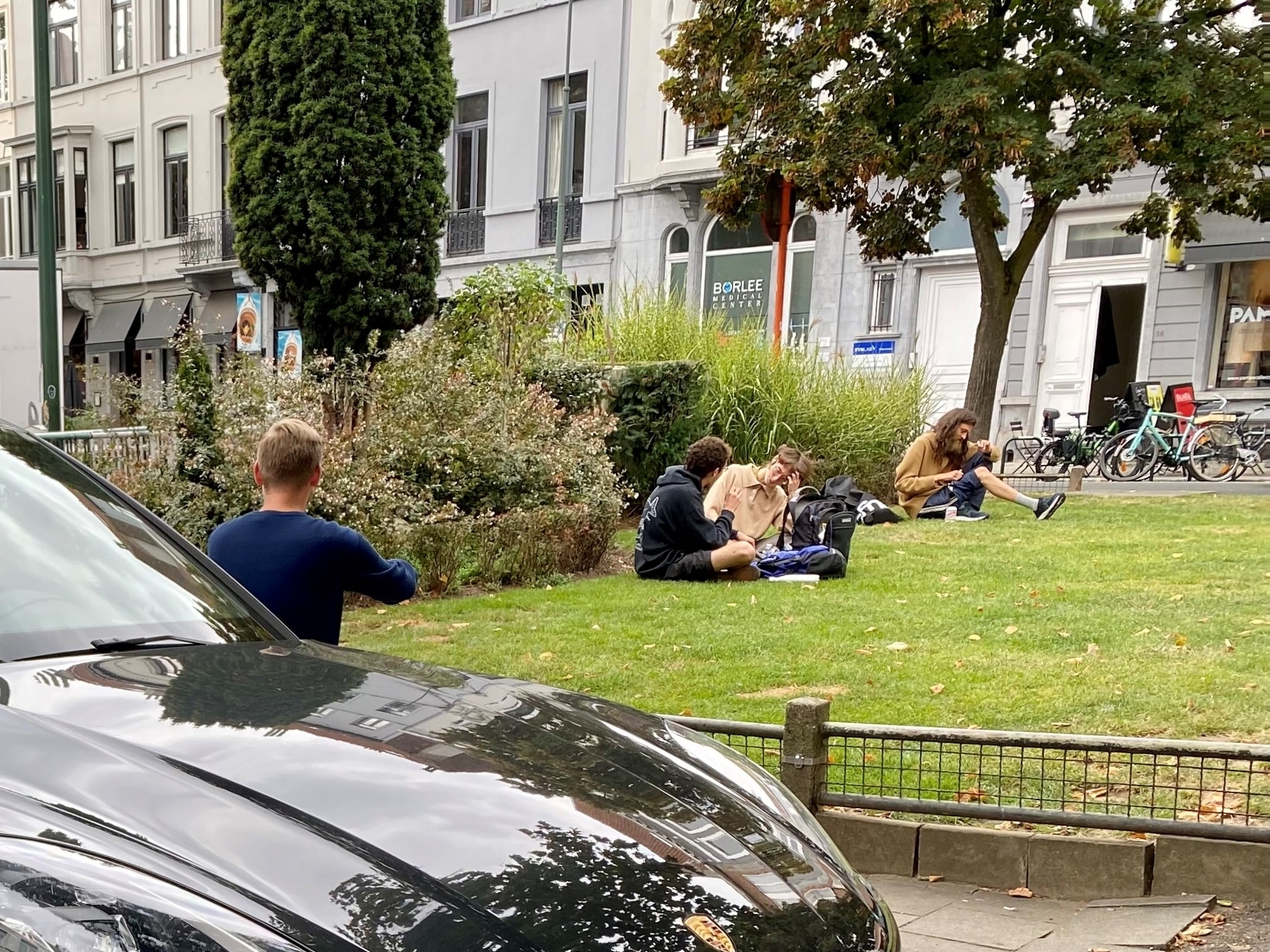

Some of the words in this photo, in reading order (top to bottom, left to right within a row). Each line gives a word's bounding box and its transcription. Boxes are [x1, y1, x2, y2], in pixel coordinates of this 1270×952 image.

[713, 279, 763, 294] BORLEE
[713, 293, 762, 302] MEDICAL
[713, 300, 761, 309] CENTER
